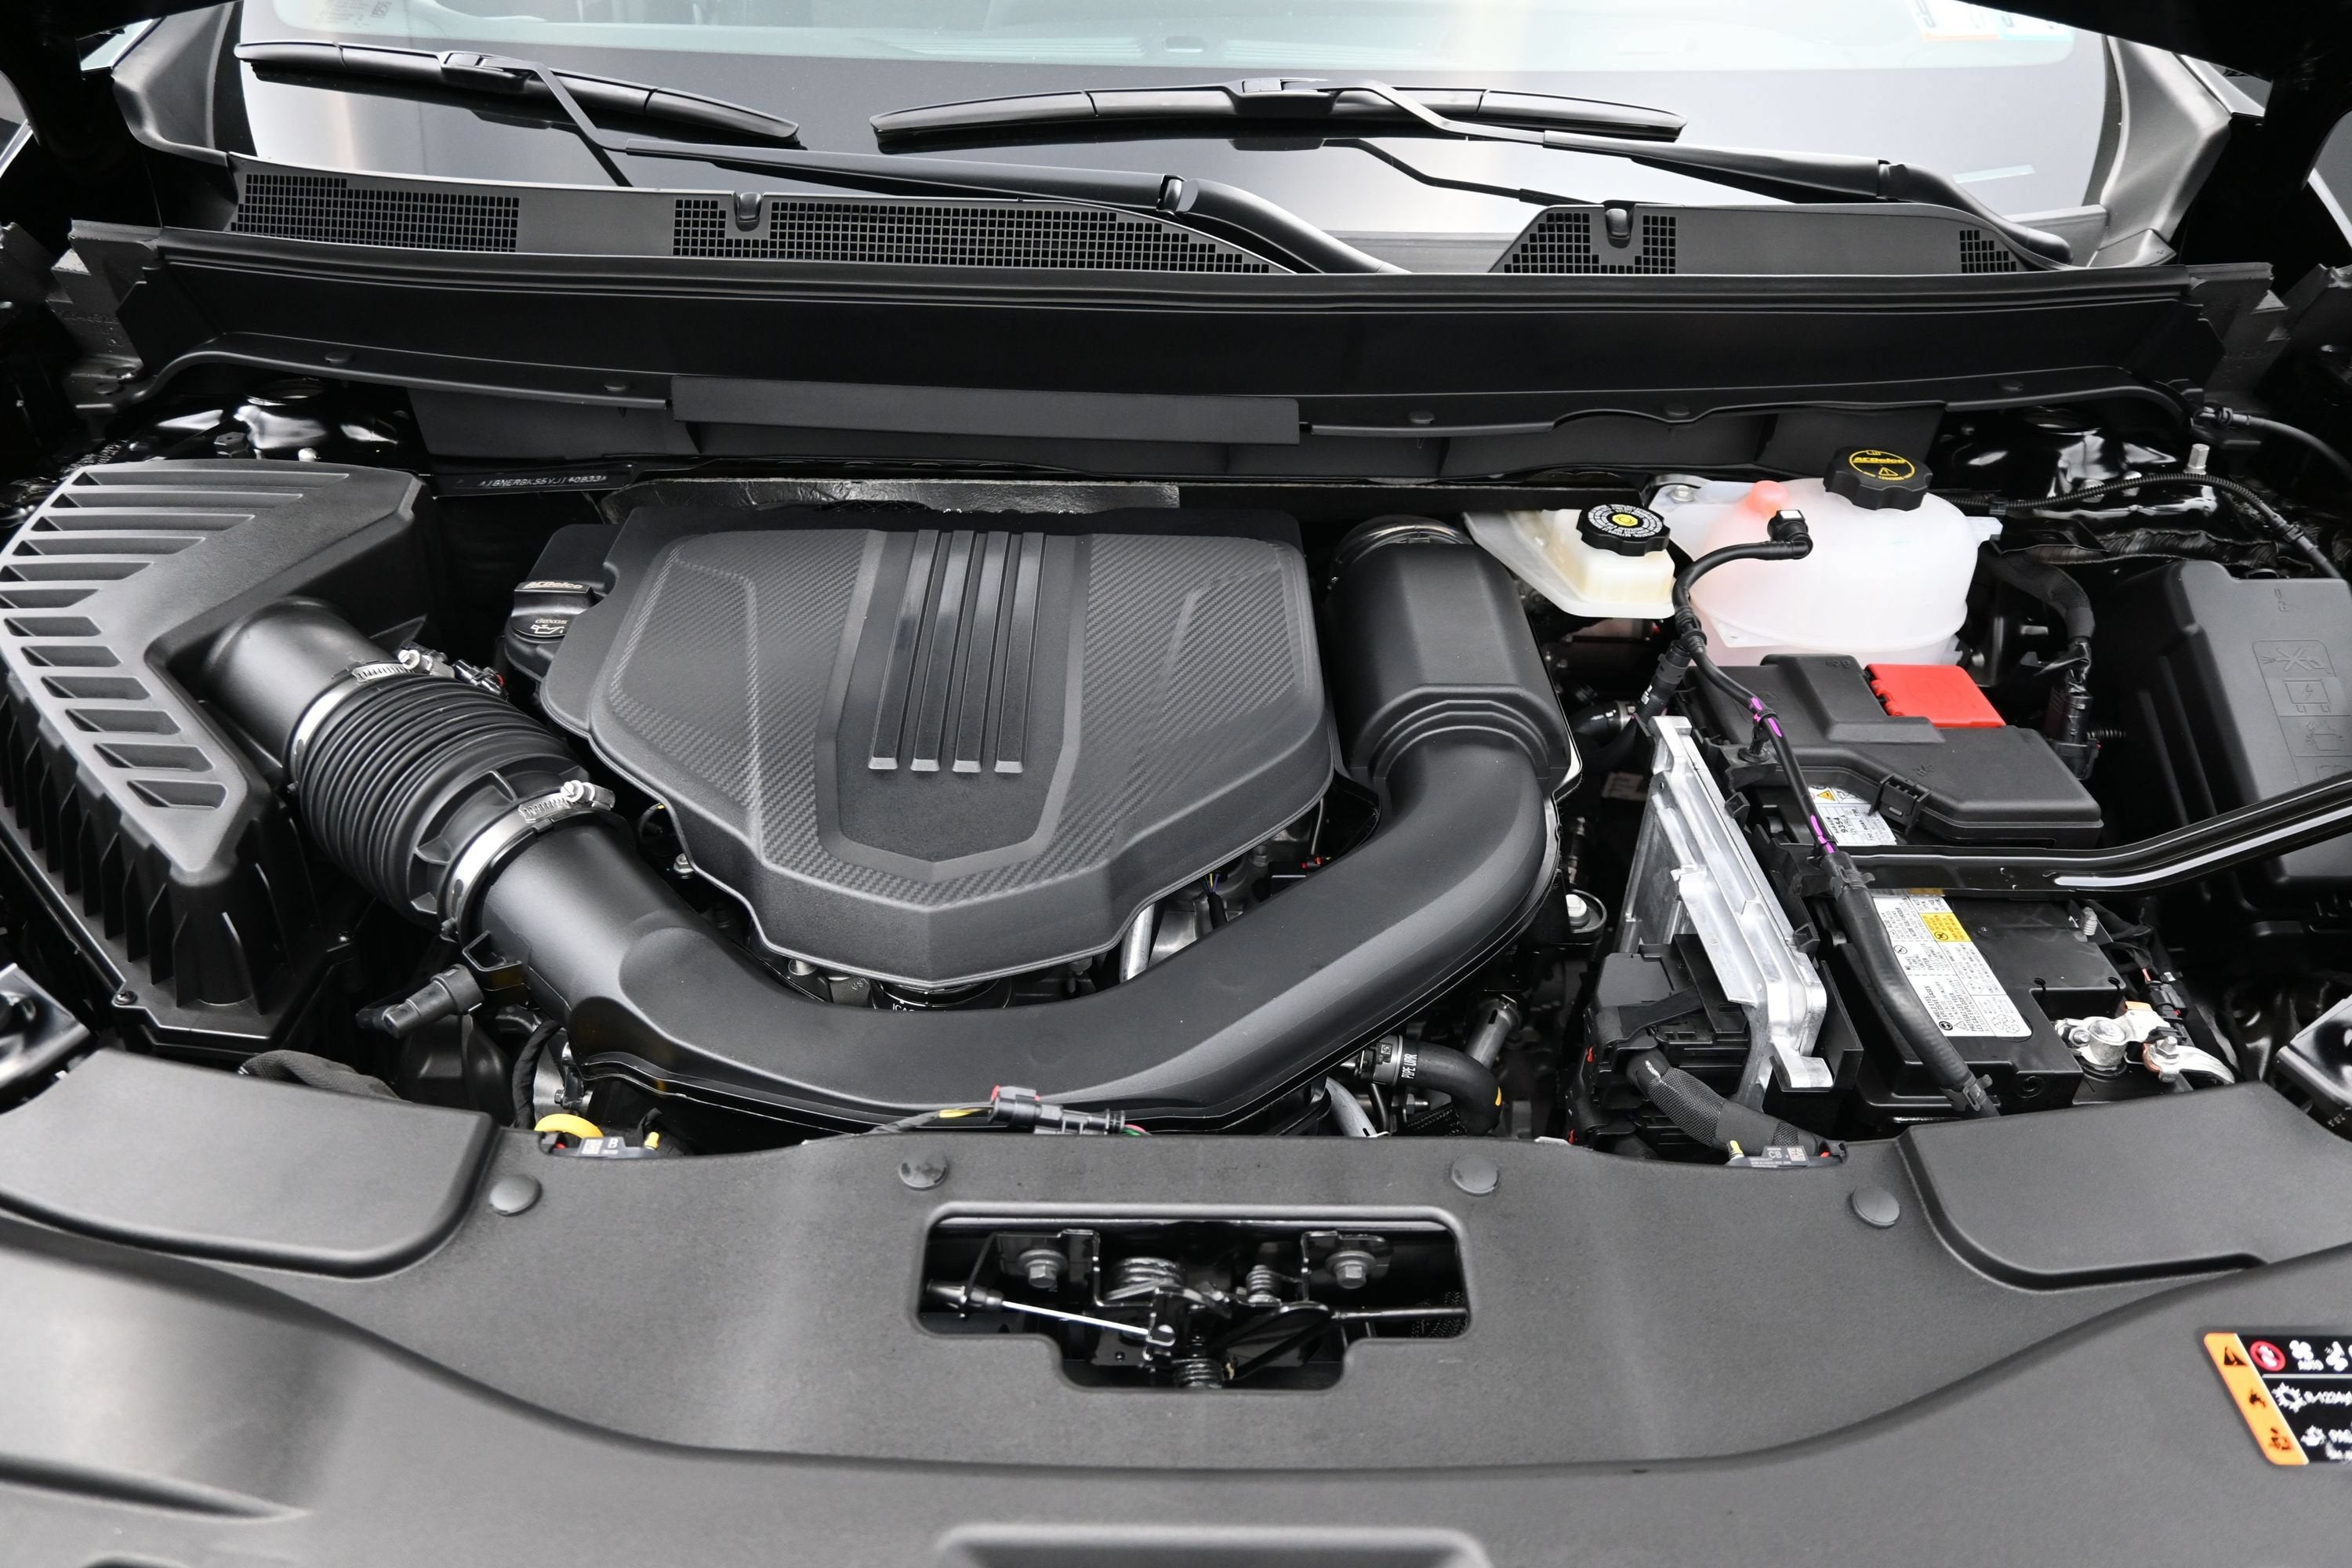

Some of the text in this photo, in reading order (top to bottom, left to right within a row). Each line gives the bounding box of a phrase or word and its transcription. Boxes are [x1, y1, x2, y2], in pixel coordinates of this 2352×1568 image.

[523, 581, 583, 590] ACDelco
[1401, 1054, 1417, 1079] PIPE UPR
[608, 1138, 619, 1149] B
